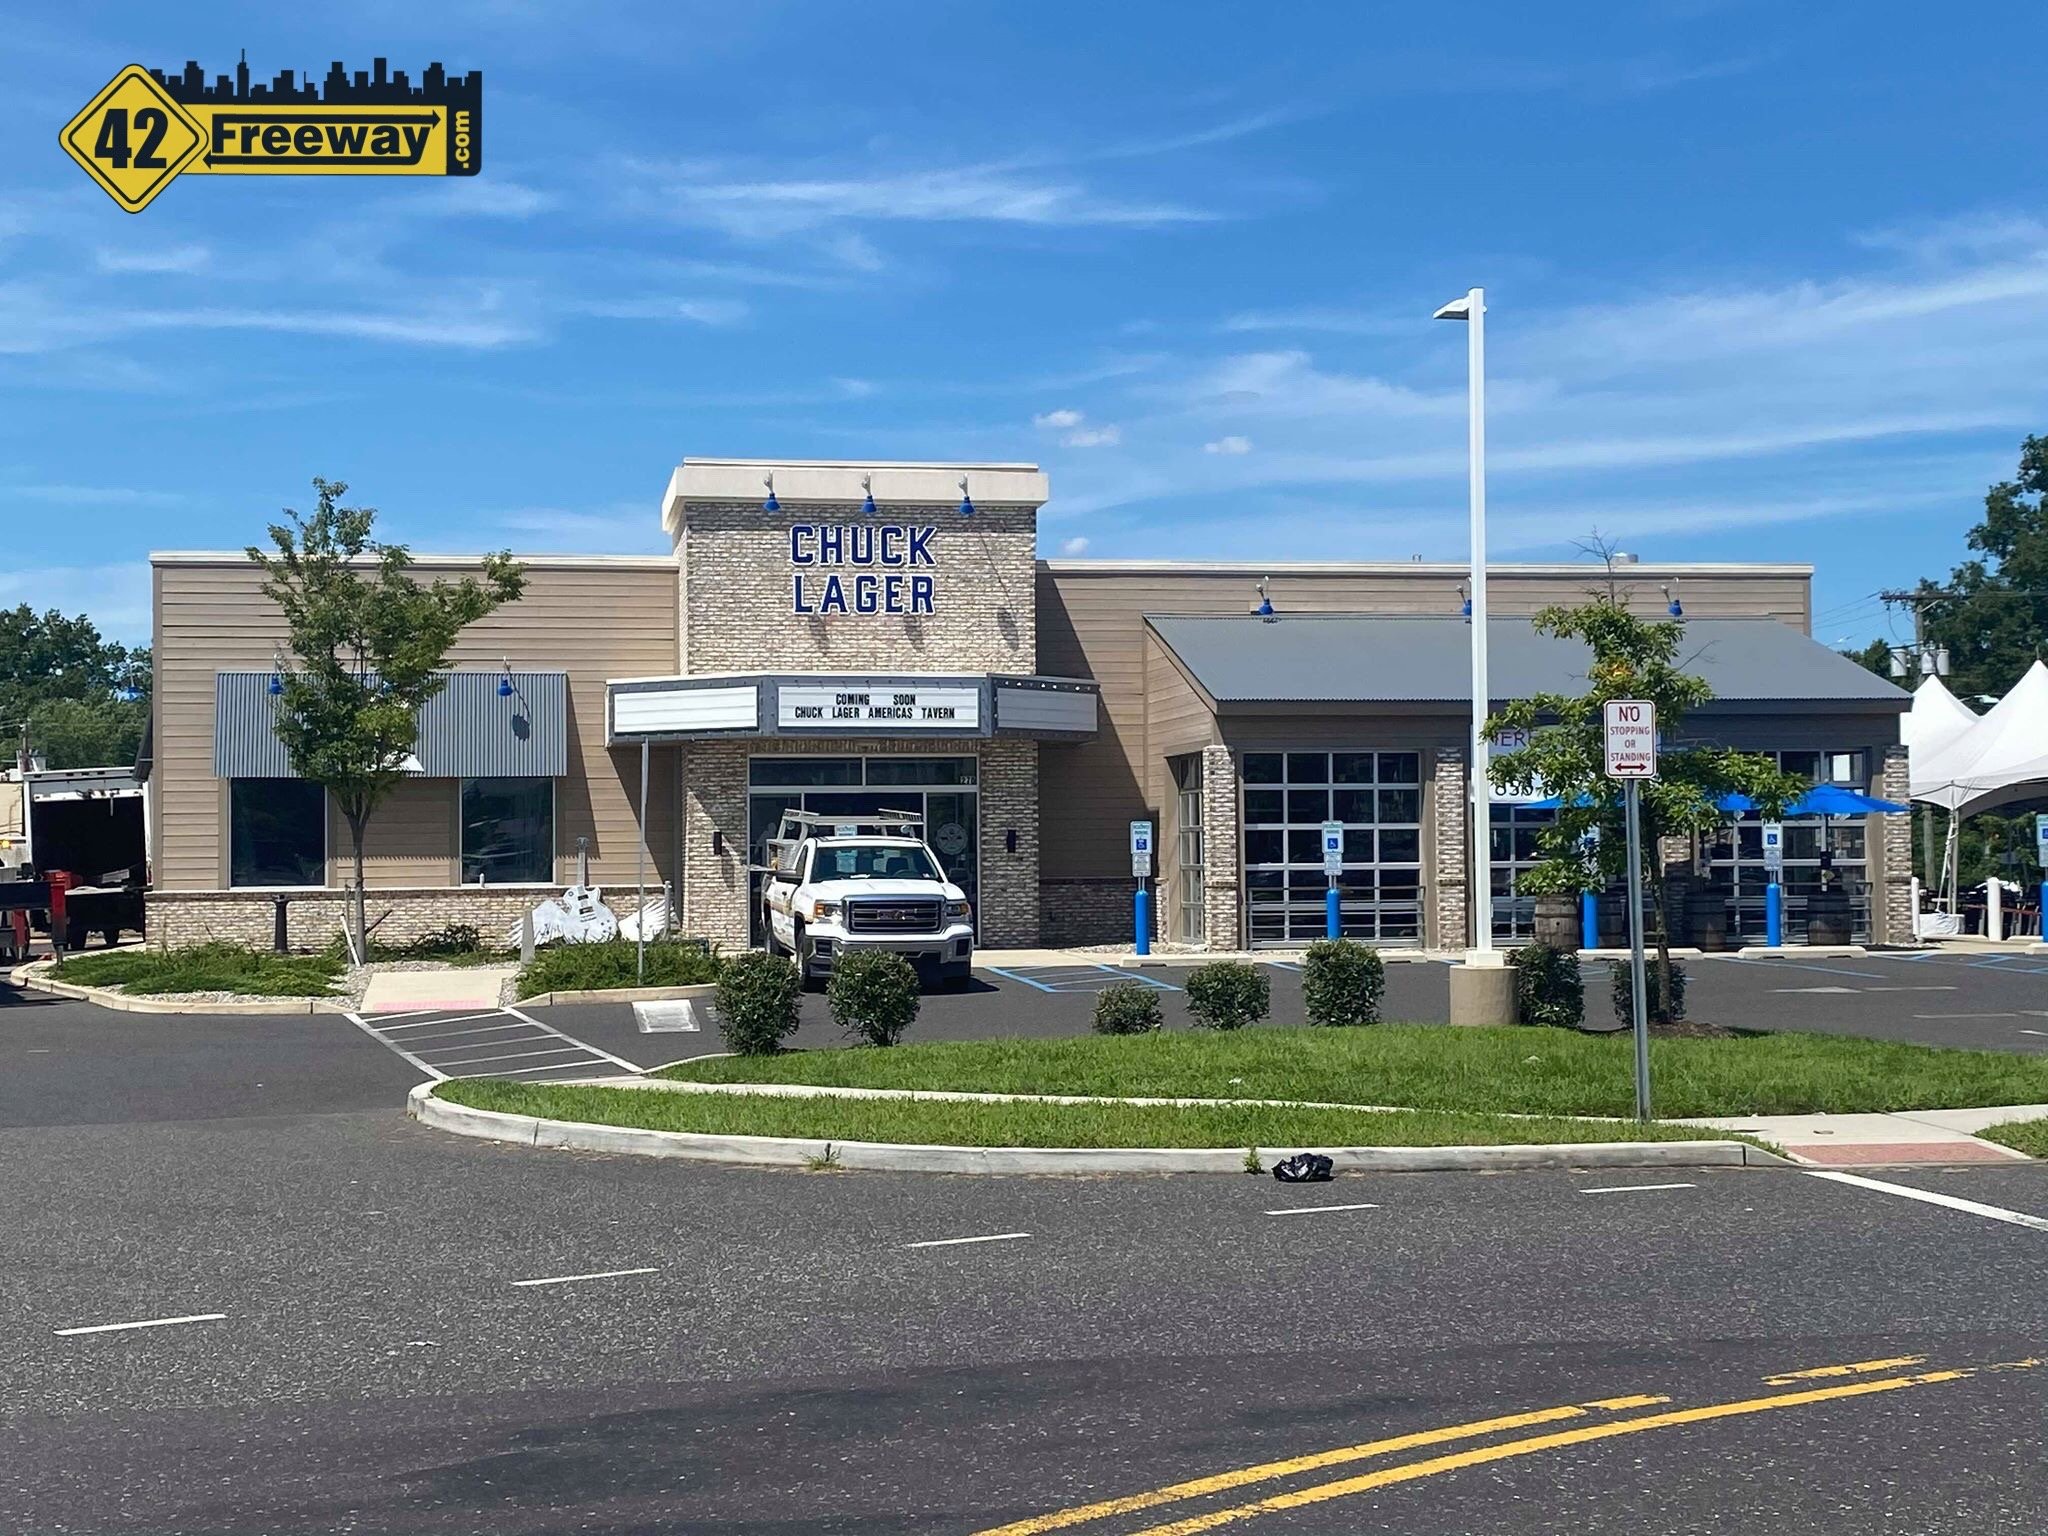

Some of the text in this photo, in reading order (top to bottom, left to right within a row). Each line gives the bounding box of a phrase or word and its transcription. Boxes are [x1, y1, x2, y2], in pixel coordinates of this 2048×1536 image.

[790, 525, 937, 566] CHUCK
[793, 573, 935, 614] LAGER
[835, 693, 916, 706] COMING SOON
[795, 706, 955, 719] CHUCK LAGER AMERICAS TAVERN
[1618, 706, 1640, 722] NO
[1610, 726, 1650, 736] STOPPING
[1624, 739, 1636, 748] OR
[1610, 752, 1651, 762] STANDING
